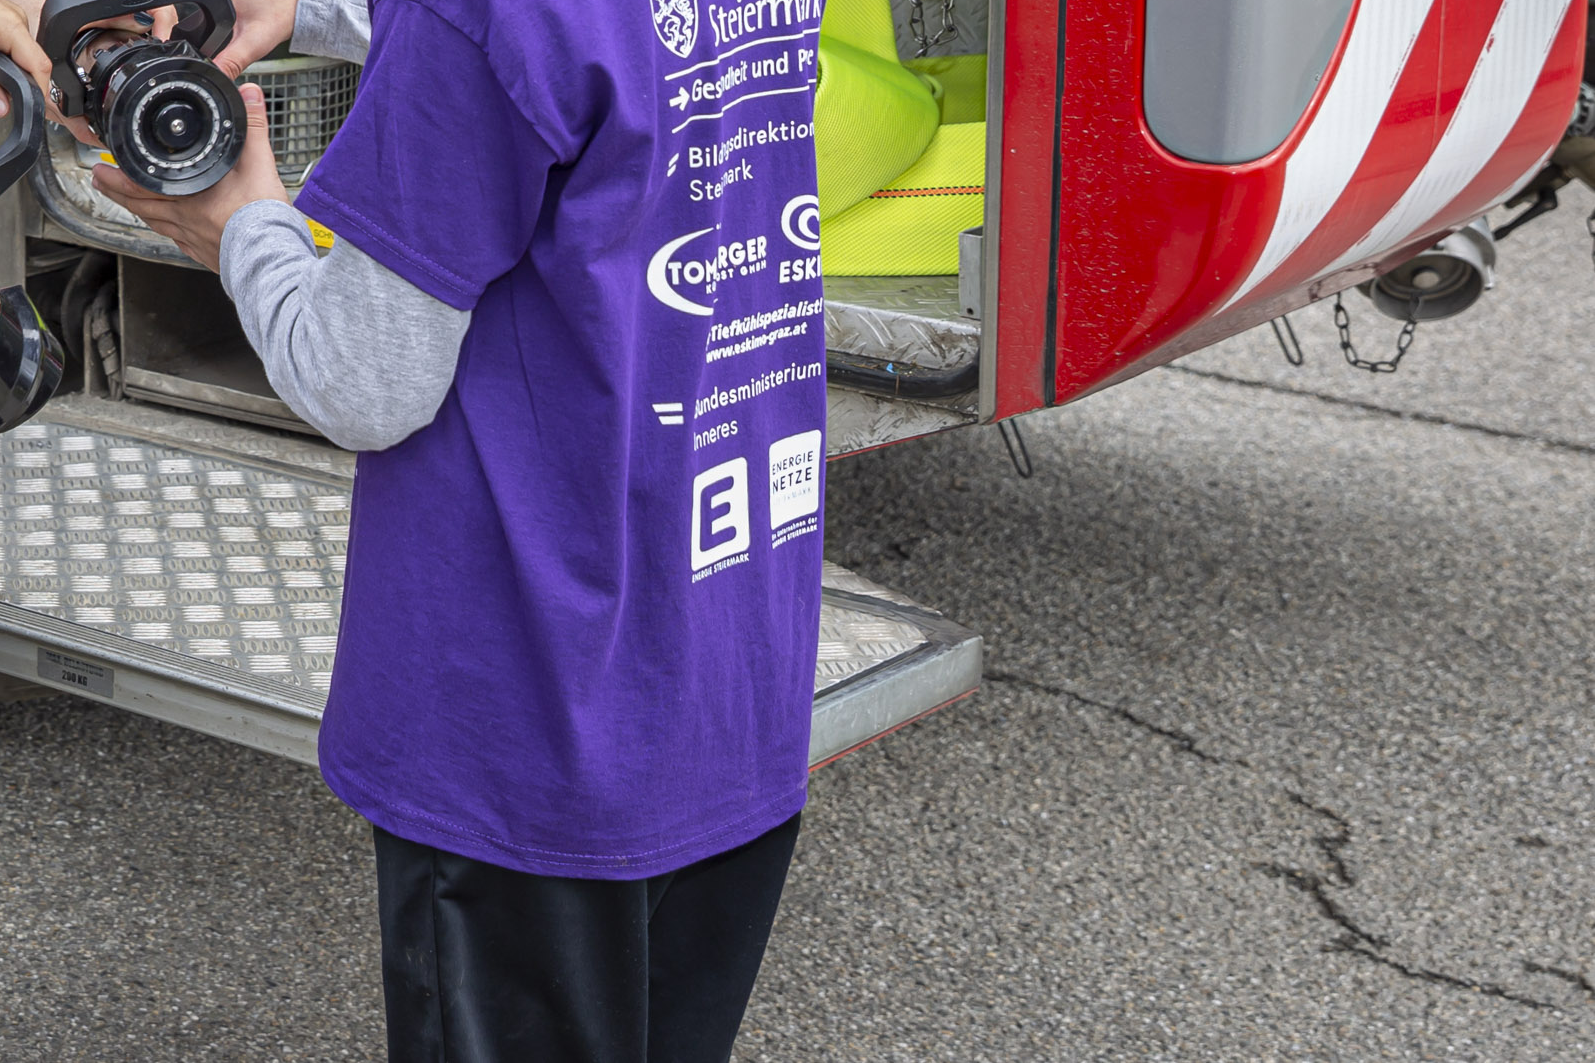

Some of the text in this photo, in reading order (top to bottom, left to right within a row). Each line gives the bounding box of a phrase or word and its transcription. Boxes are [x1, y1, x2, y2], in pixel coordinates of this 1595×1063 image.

[752, 51, 789, 78] und
[772, 450, 814, 476] ENERGIE
[772, 467, 813, 495] NETZE
[692, 552, 750, 584] ENERGIE STEIERMARK
[61, 669, 88, 687] 200 KG
